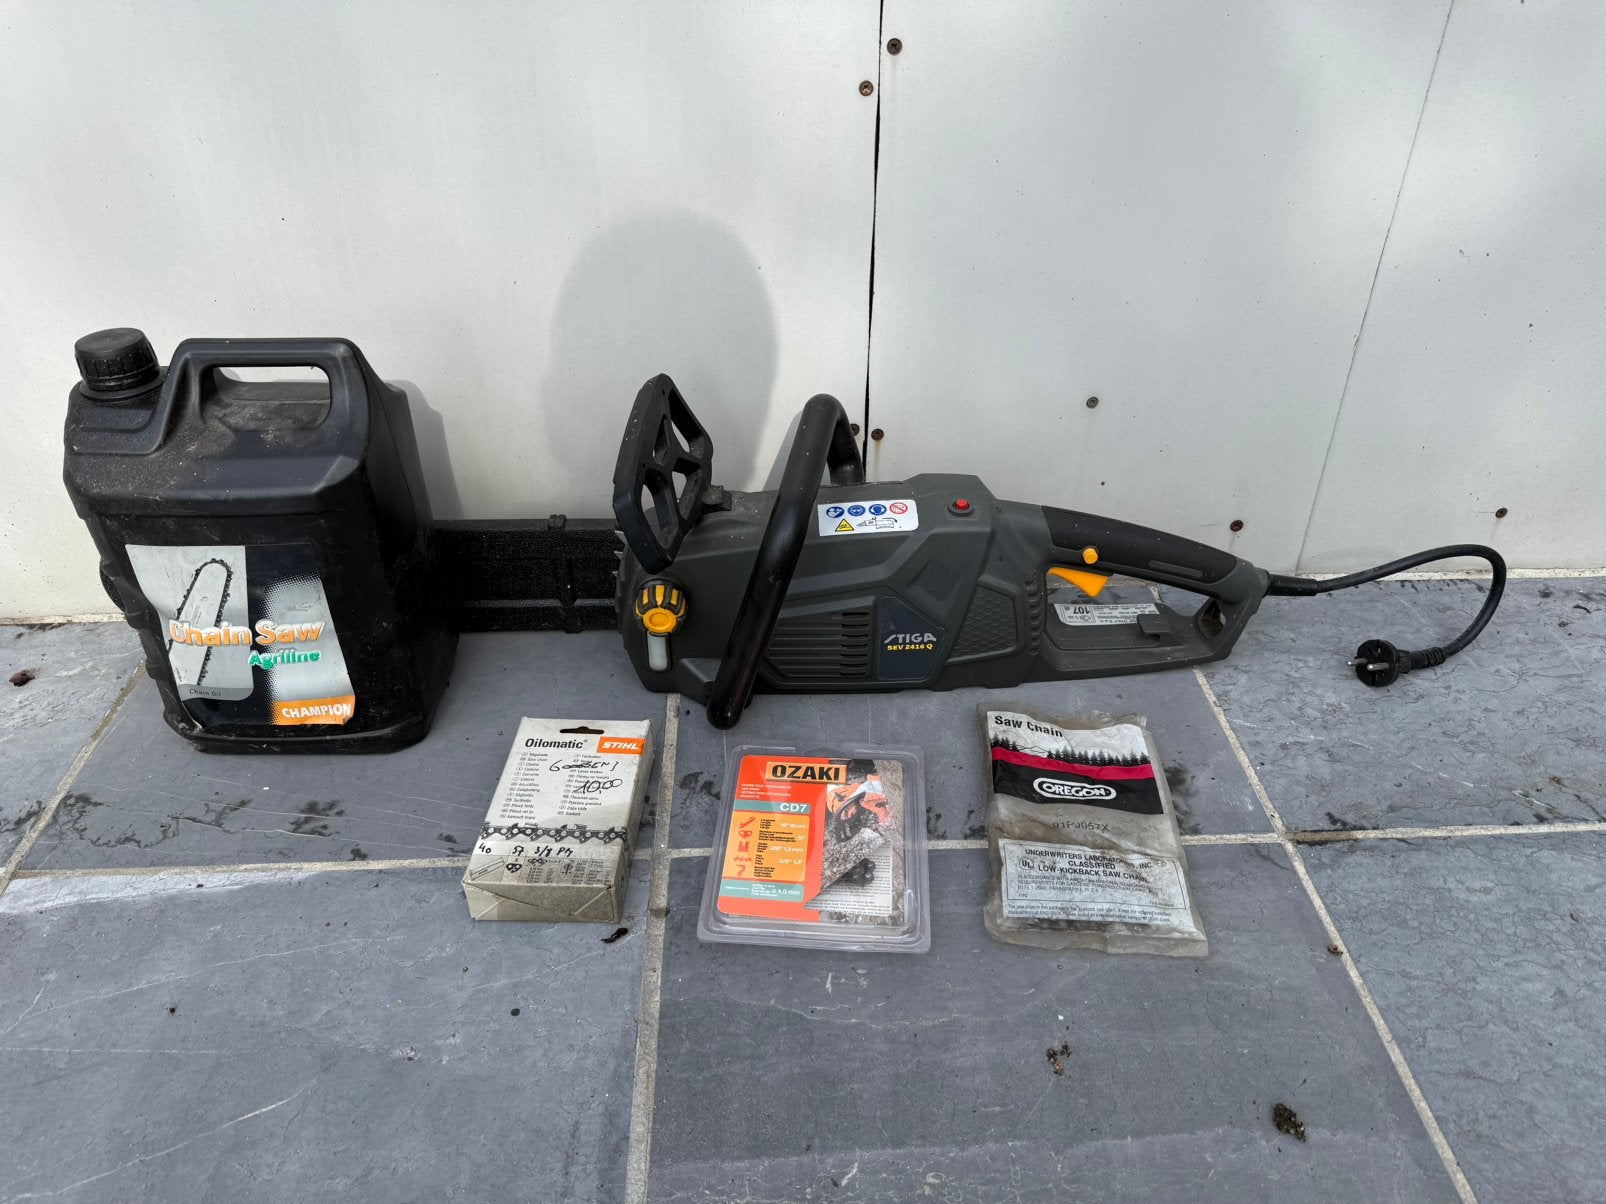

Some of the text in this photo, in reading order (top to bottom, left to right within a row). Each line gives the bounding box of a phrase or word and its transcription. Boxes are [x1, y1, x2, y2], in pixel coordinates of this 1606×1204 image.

[1073, 606, 1090, 614] 107
[169, 619, 325, 647] Chain Saw
[884, 632, 937, 644] STIGA
[248, 650, 321, 669] Agriline
[189, 688, 210, 696] Chain
[281, 703, 352, 719] CHAMPION
[994, 715, 1063, 738] Saw Chain
[525, 738, 584, 749] Oilomatic
[601, 741, 640, 750] STIHL
[771, 764, 840, 781] OZAKI
[1042, 782, 1107, 798] OREGON
[780, 802, 808, 813] CD7
[1025, 849, 1083, 860] UNDERWRITERS
[1021, 859, 1032, 869] UL
[1068, 860, 1116, 870] CLASSIFIED
[1102, 869, 1121, 878] SAW
